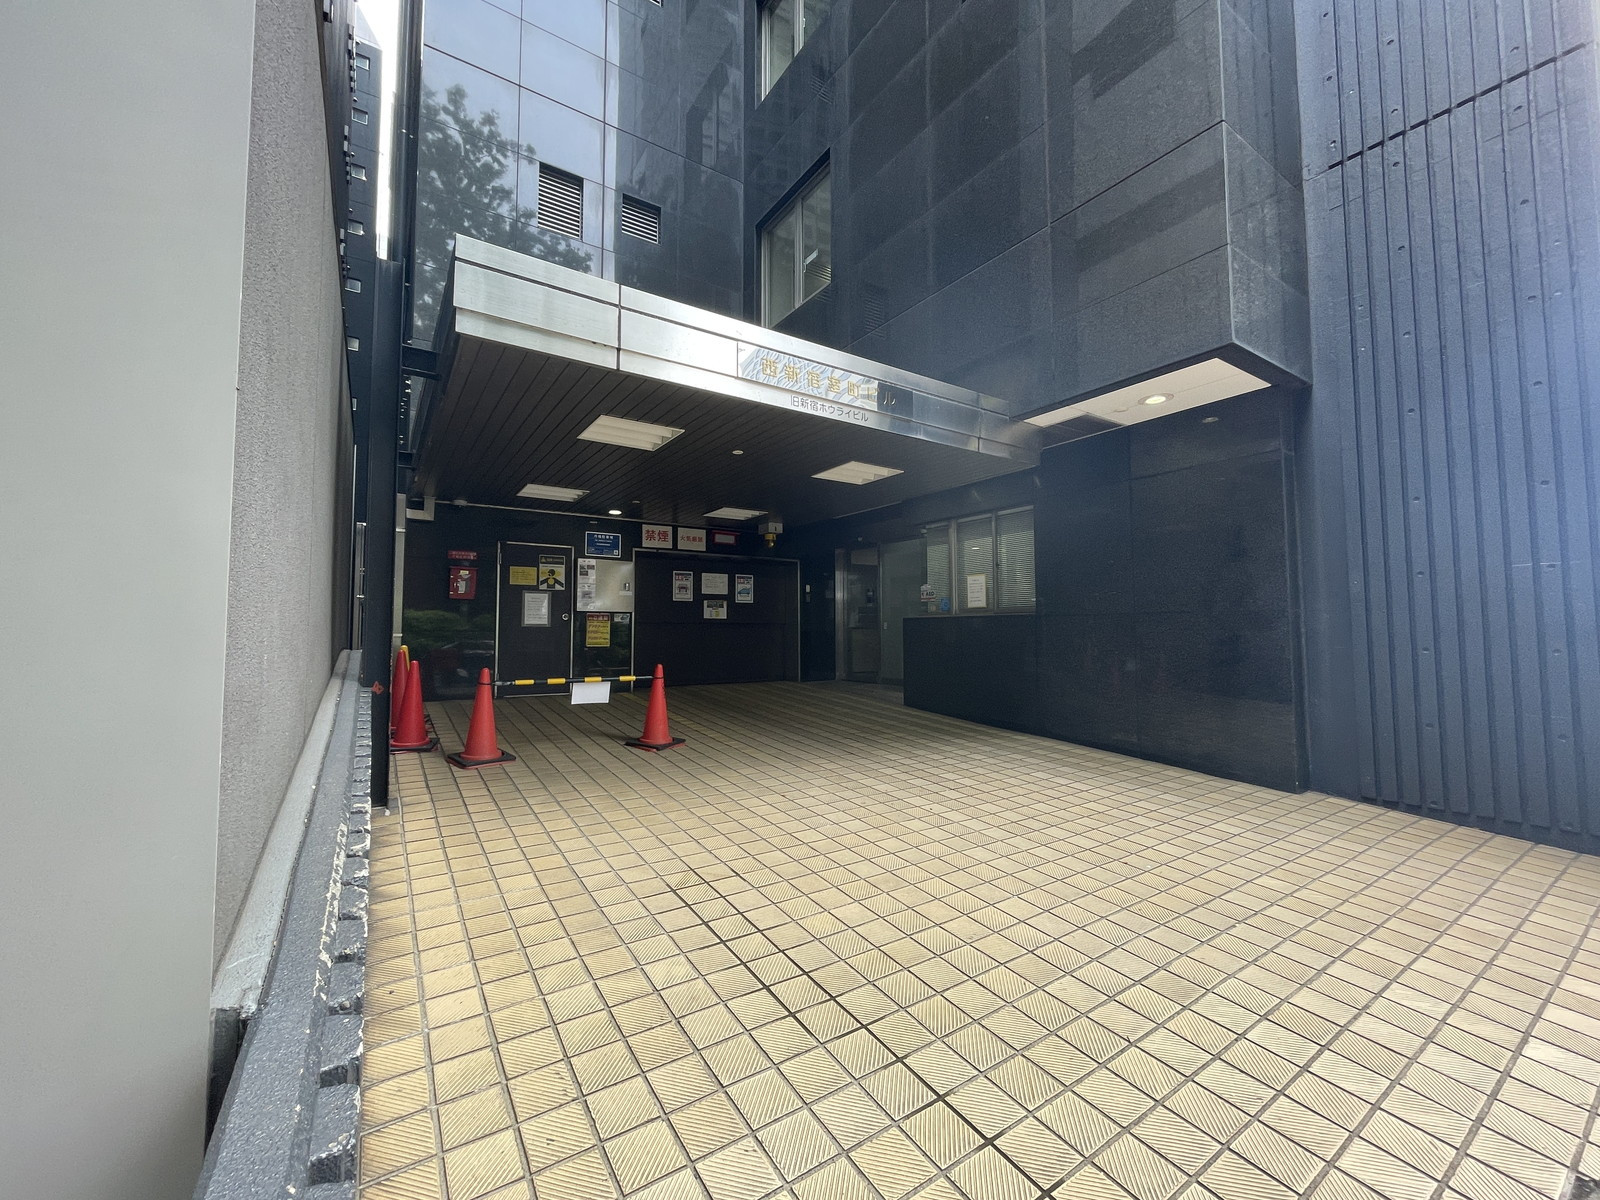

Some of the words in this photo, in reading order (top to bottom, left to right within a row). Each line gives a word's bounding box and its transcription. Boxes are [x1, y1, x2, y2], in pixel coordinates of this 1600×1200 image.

[790, 394, 869, 423] 旧新宿ホウライビル
[645, 529, 669, 542] 禁煙
